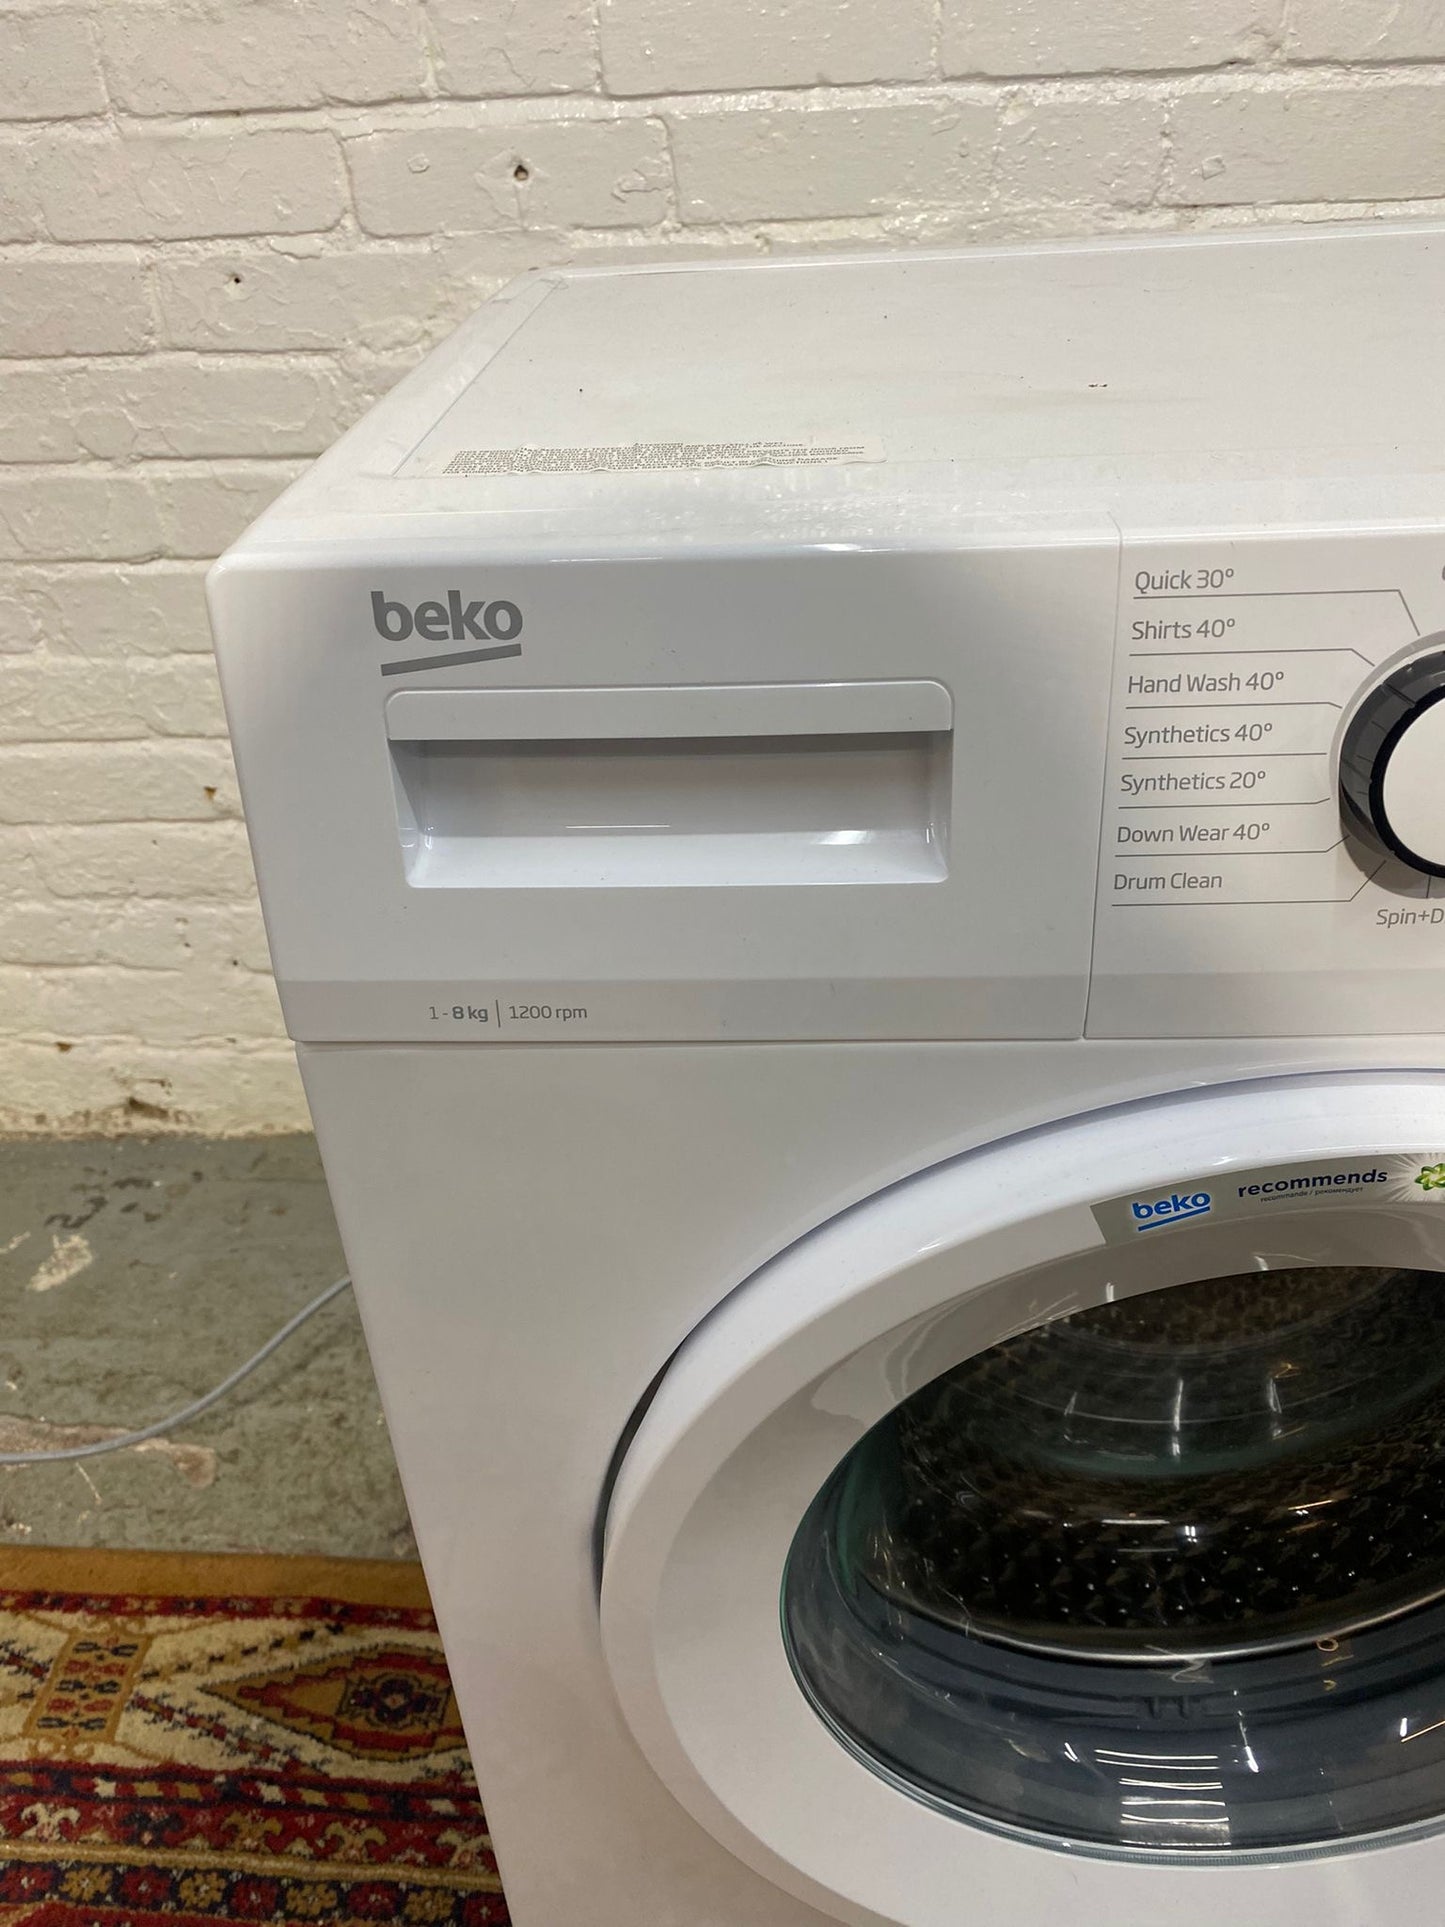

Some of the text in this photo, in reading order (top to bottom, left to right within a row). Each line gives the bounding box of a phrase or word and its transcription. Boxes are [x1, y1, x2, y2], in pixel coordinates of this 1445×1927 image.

[1134, 569, 1192, 594] Quick
[371, 590, 523, 641] beko
[1131, 619, 1192, 640] Shirts
[1127, 673, 1181, 694] Hand
[1186, 672, 1241, 692] Wash
[1123, 724, 1230, 749] Synthetics
[1120, 771, 1226, 796] Synthetics
[1117, 824, 1174, 843] Down
[1178, 823, 1230, 842] Wear
[1113, 871, 1223, 890] Drum Clean
[467, 1005, 489, 1023] kg
[509, 1005, 552, 1020] 1200
[555, 1008, 588, 1022] rpm
[1131, 1168, 1389, 1220] beko recommends
